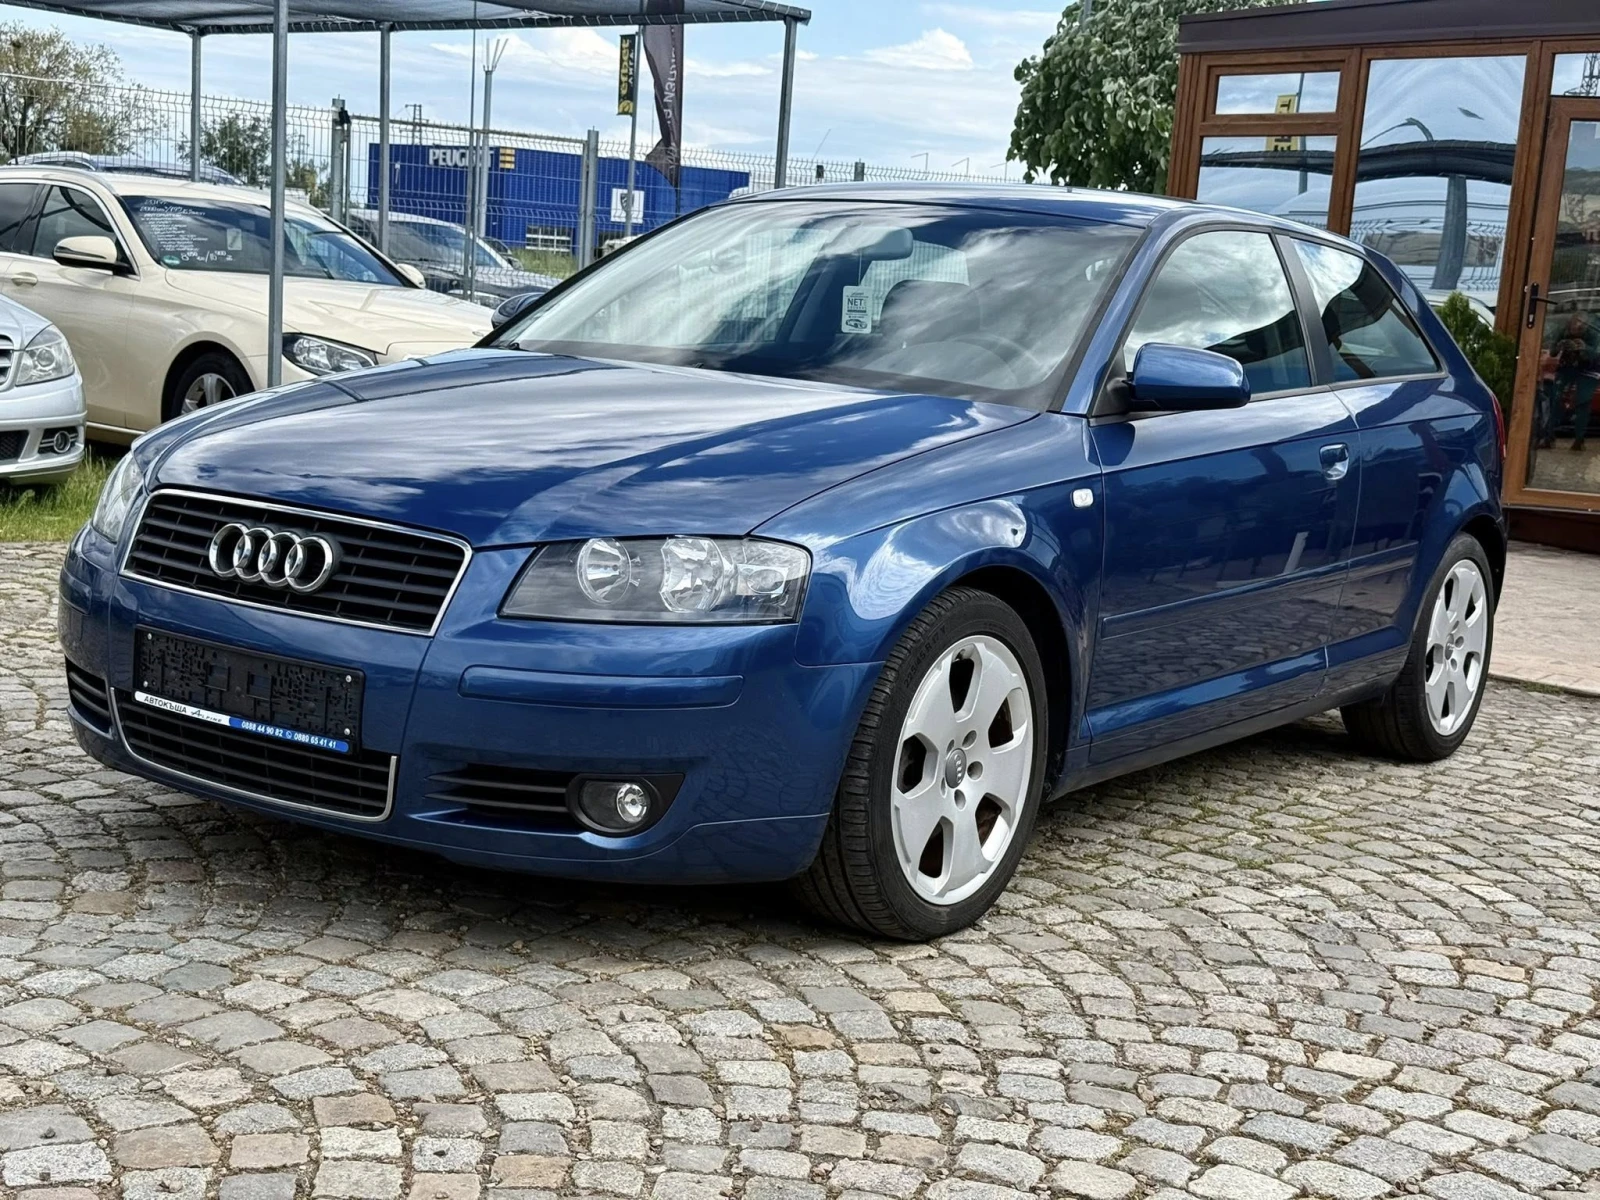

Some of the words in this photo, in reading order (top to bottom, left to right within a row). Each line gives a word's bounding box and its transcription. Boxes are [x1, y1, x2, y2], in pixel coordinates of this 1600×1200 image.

[257, 724, 265, 733] 44
[266, 726, 274, 735] 90
[275, 728, 283, 737] 82
[310, 736, 318, 745] 65
[319, 738, 327, 747] 41
[328, 740, 336, 749] 41
